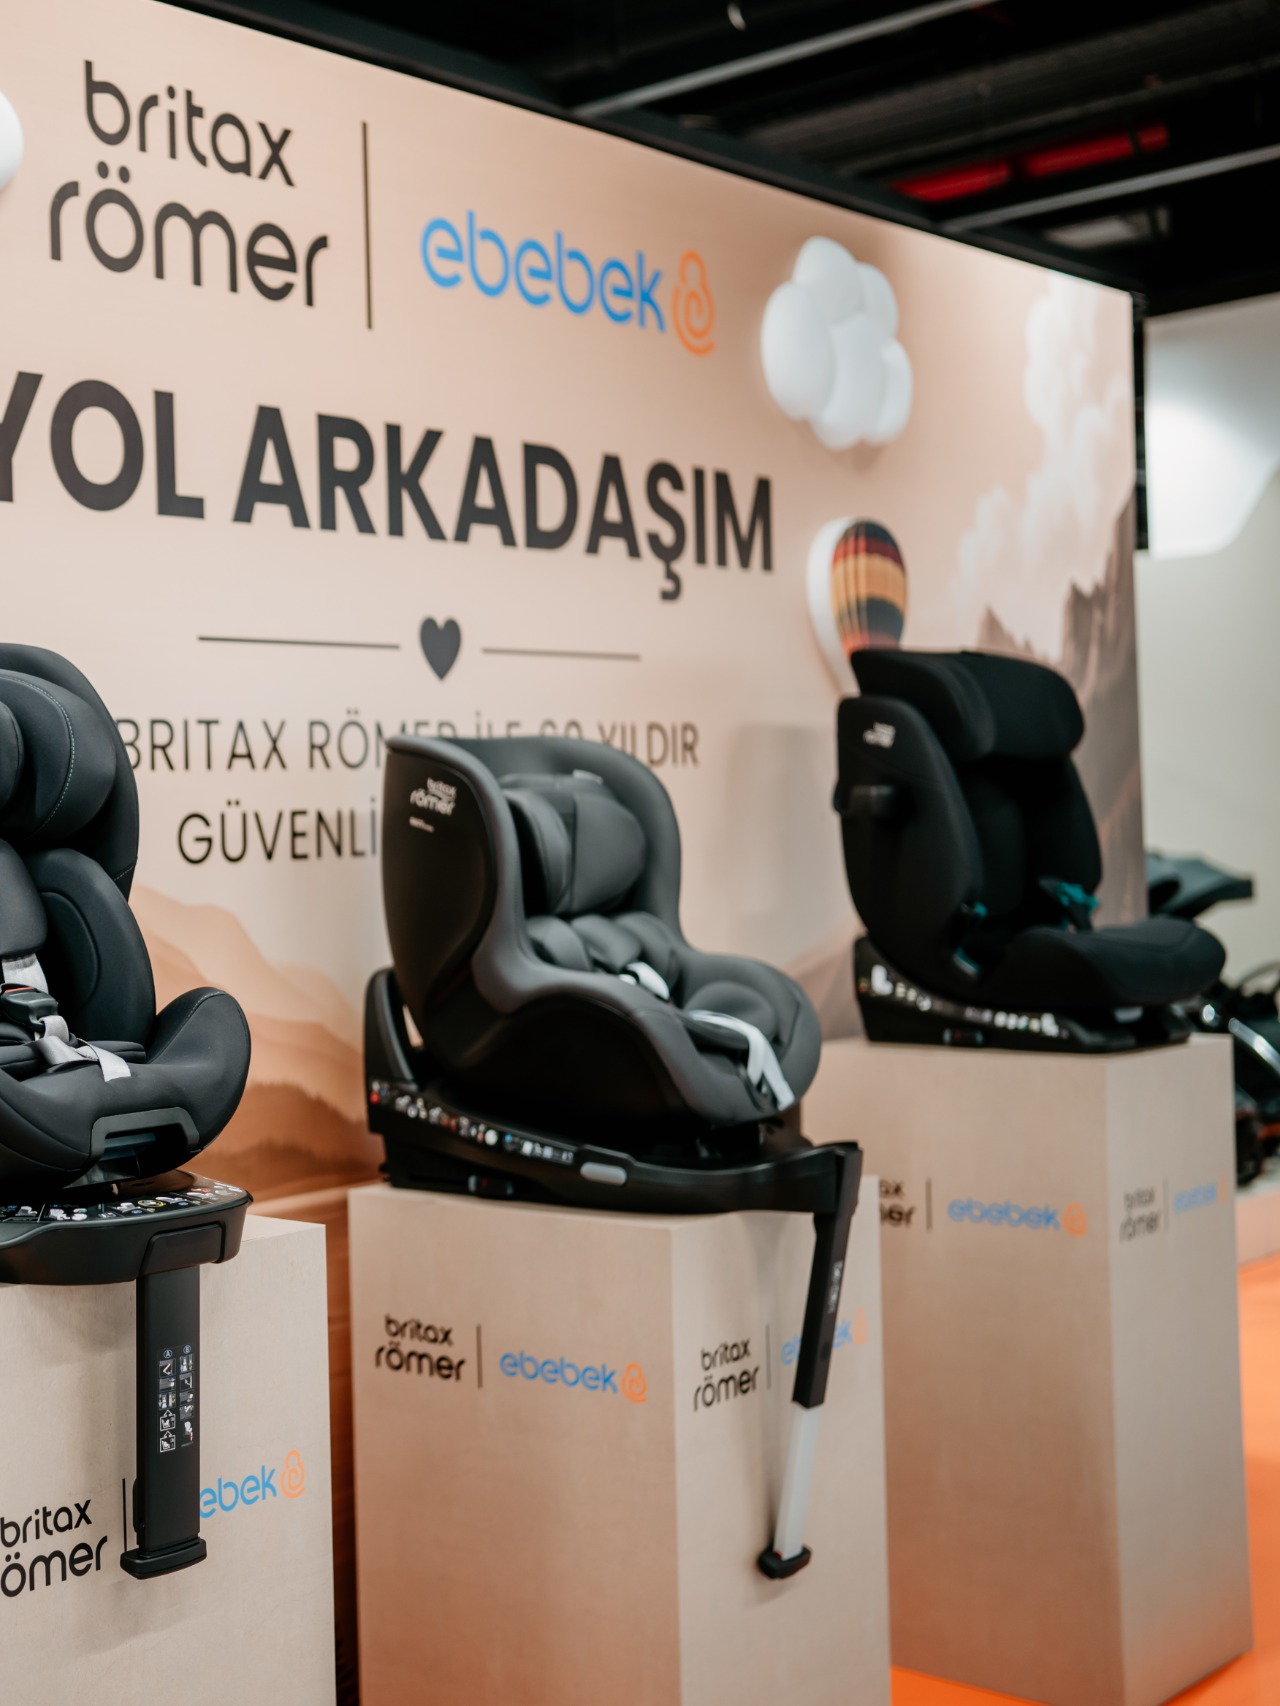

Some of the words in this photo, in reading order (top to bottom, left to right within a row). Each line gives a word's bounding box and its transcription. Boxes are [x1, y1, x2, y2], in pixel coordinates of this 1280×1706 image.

[84, 60, 296, 187] britax
[50, 161, 328, 307] römer
[421, 210, 666, 333] ebebek
[232, 404, 774, 602] ARKADAŞIM
[116, 719, 287, 771] BRITAX
[177, 797, 377, 864] GÜVENLİ
[385, 1313, 453, 1346] britax
[701, 1338, 751, 1371] britax
[375, 1341, 466, 1381] römer
[500, 1350, 618, 1393] ebebek
[693, 1366, 760, 1412] römer
[199, 1465, 277, 1519] ebek
[0, 1499, 92, 1548] britax
